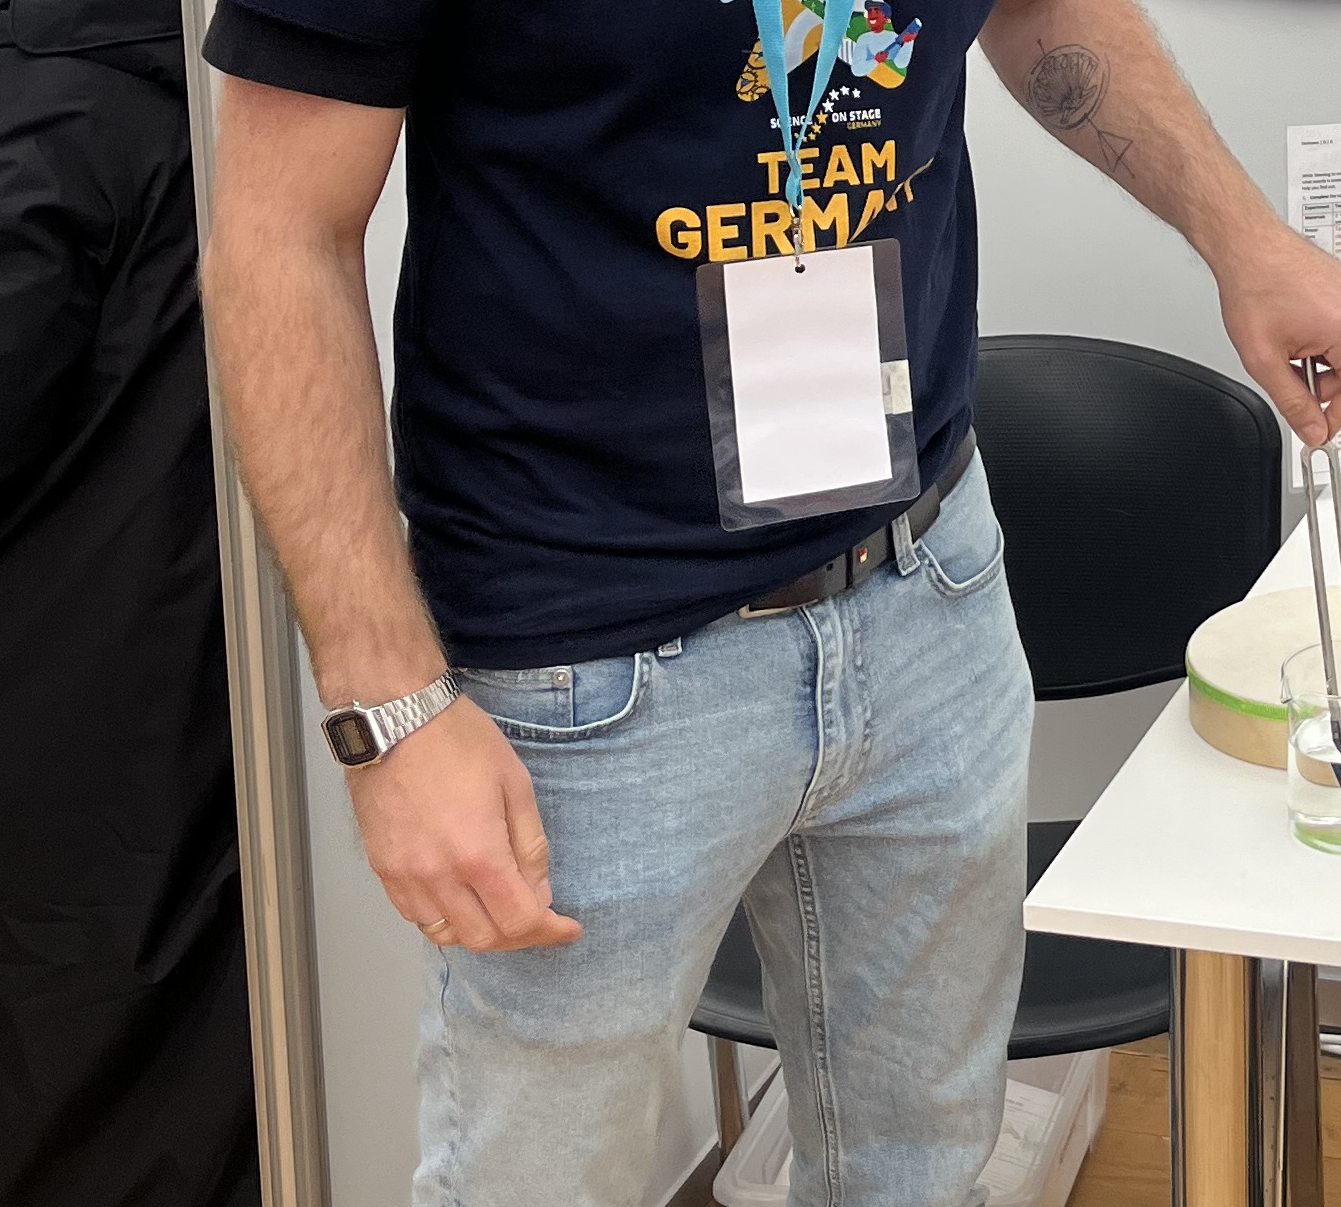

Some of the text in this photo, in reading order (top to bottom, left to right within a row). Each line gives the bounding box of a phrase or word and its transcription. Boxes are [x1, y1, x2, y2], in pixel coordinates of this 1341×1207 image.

[831, 111, 847, 123] ON
[849, 108, 882, 121] STAGE
[847, 119, 882, 130] GERMANY
[757, 139, 896, 194] TEAM
